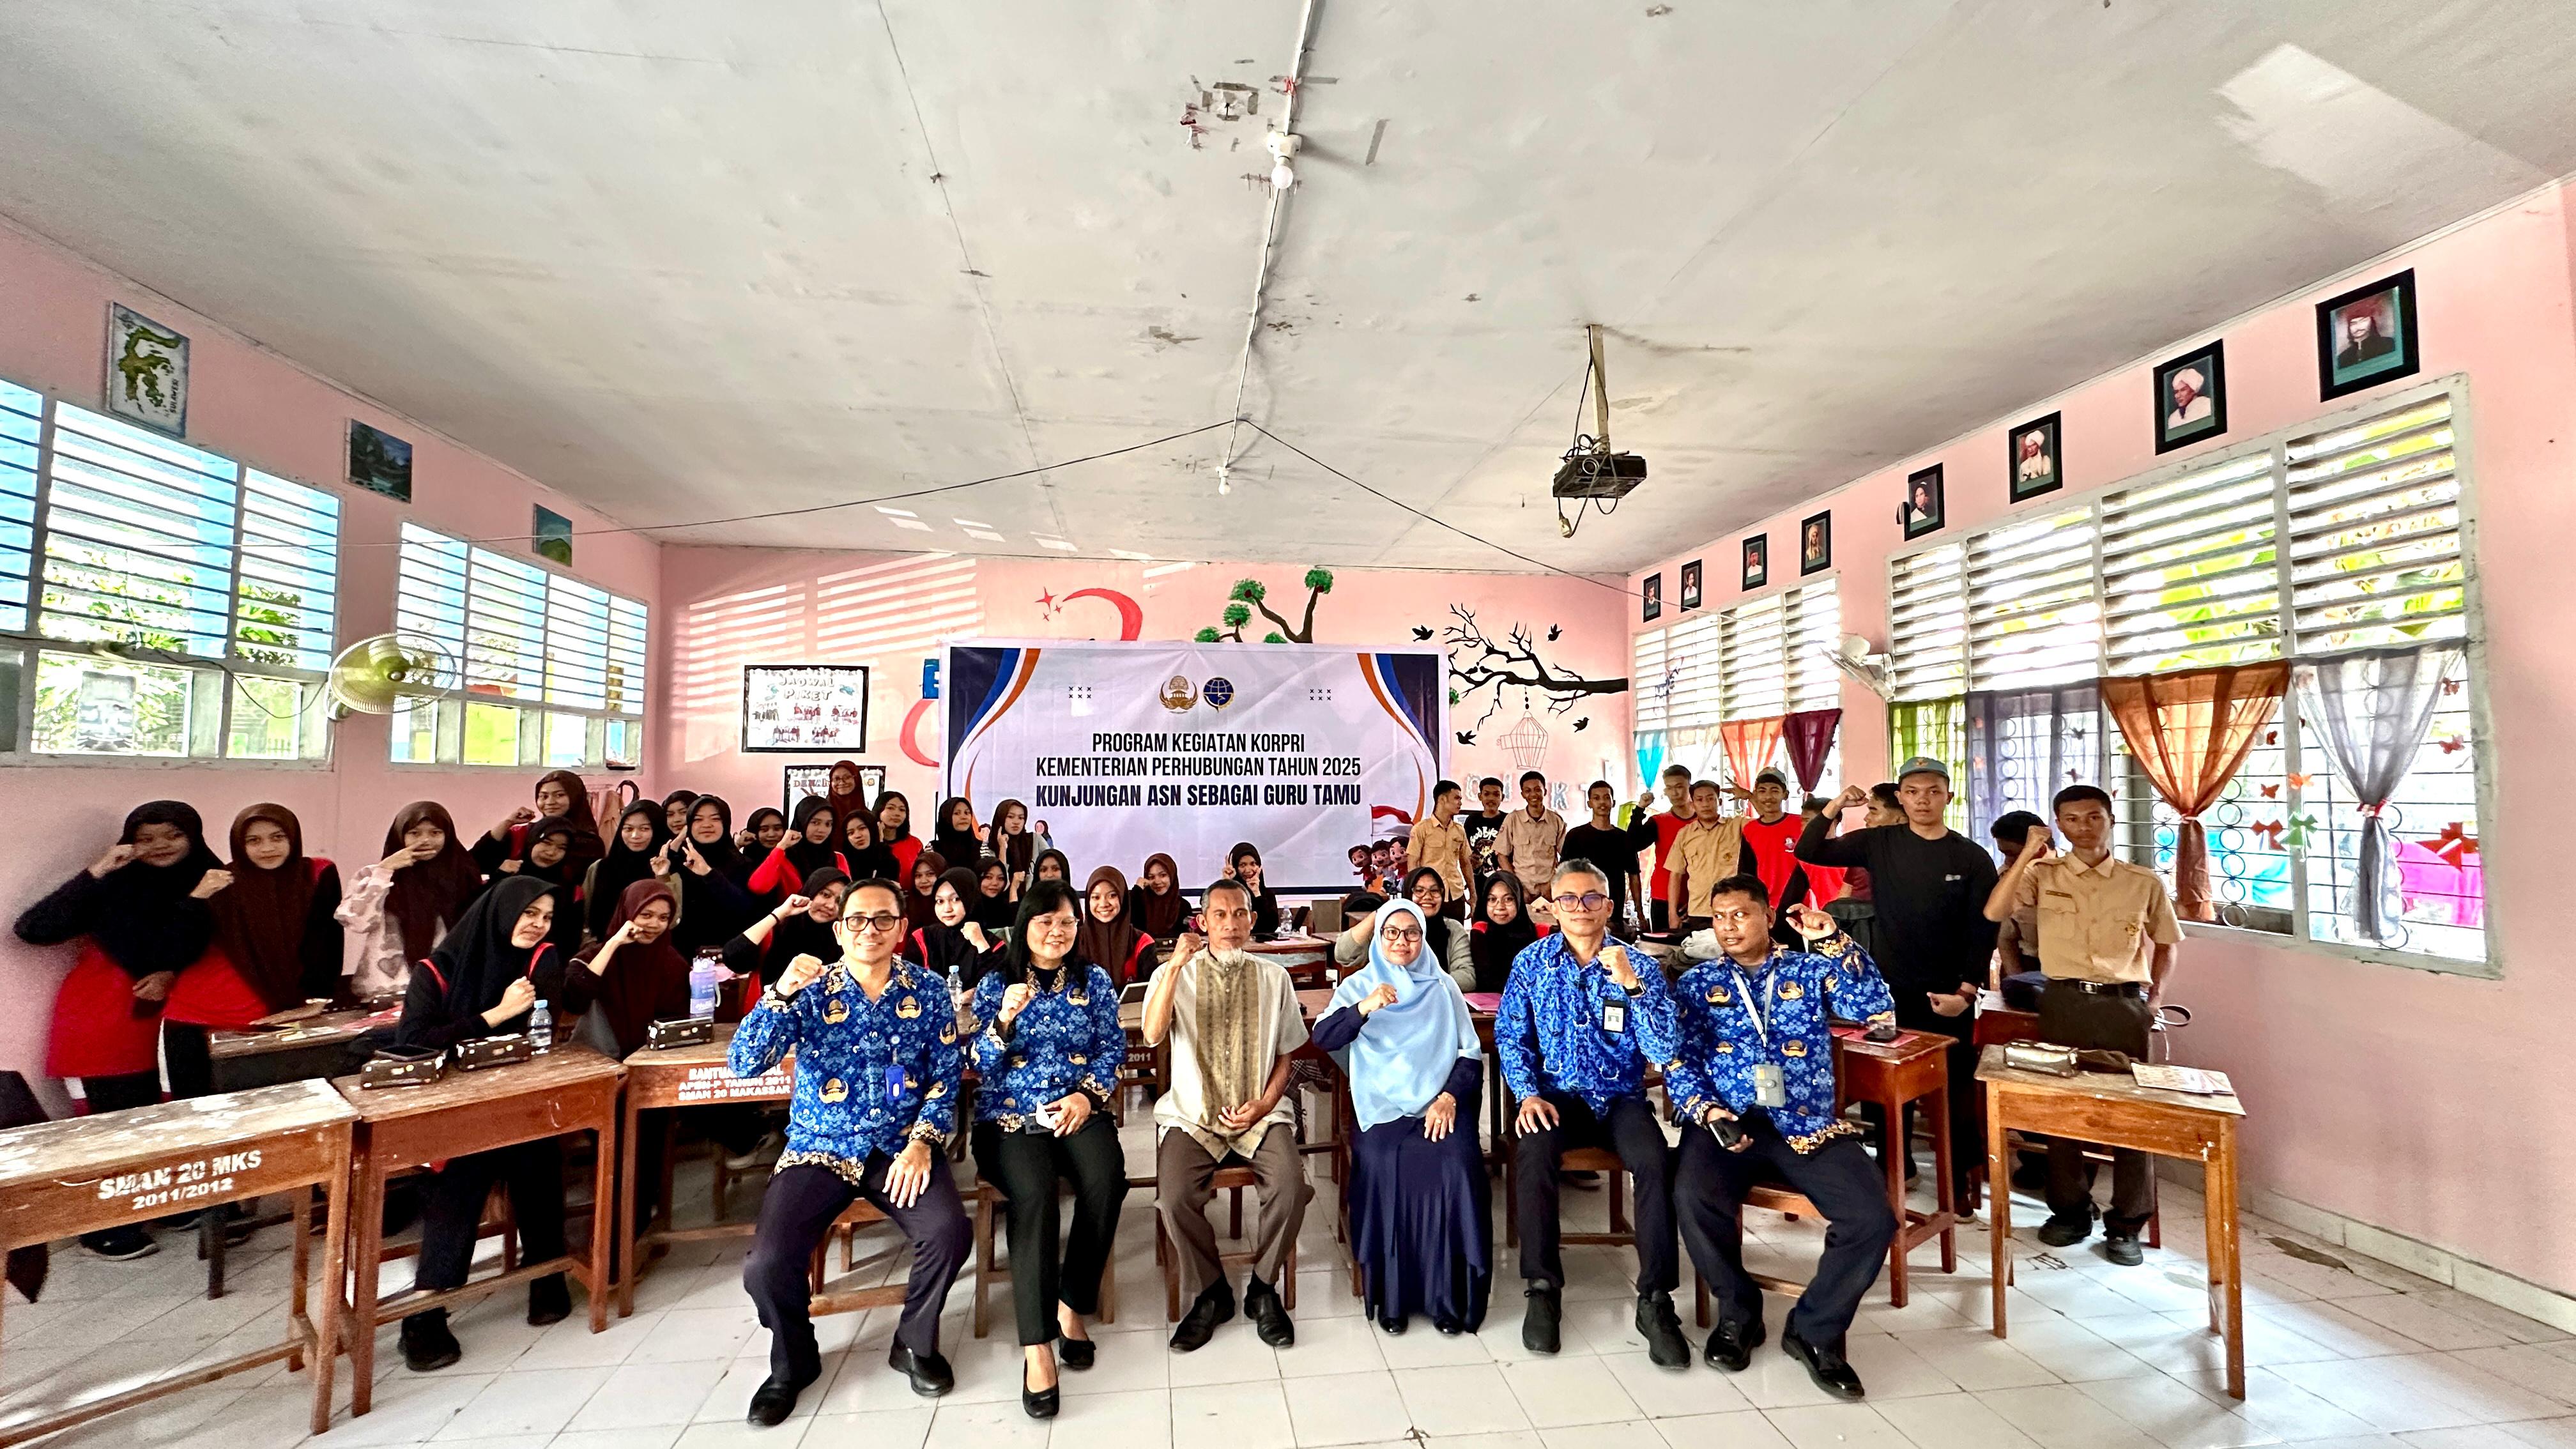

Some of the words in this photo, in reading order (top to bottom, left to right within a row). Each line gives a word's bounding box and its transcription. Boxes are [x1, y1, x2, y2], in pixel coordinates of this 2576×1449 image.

[779, 677, 834, 687] JADWAL
[783, 689, 832, 702] PIKET
[1092, 733, 1167, 752] PROGRAM
[1172, 733, 1246, 752] KEGIATAN
[1251, 733, 1305, 753] KORPRI
[1036, 757, 1147, 776] KEMENTERIAN
[1152, 757, 1264, 776] PERHUBUNGAN
[1268, 757, 1318, 776] TAHUN
[1322, 757, 1361, 776] 2025
[1036, 785, 1141, 807] KUNJUNGAN
[1147, 785, 1181, 806] ASN
[1187, 785, 1258, 806] SEBAGAI
[1264, 784, 1308, 806] GURU
[1313, 784, 1361, 805] TAMU
[1128, 1052, 1151, 1062] 2011
[689, 1066, 738, 1080] BANTUA
[765, 1075, 791, 1085] 2011
[678, 1091, 711, 1101] SMAN
[714, 1089, 728, 1098] 20
[730, 1085, 791, 1097] MAKASSAR
[98, 1167, 172, 1200] SMAN
[177, 1161, 206, 1184] 20
[211, 1150, 262, 1177] MKS
[132, 1177, 234, 1210] 2011/2012
